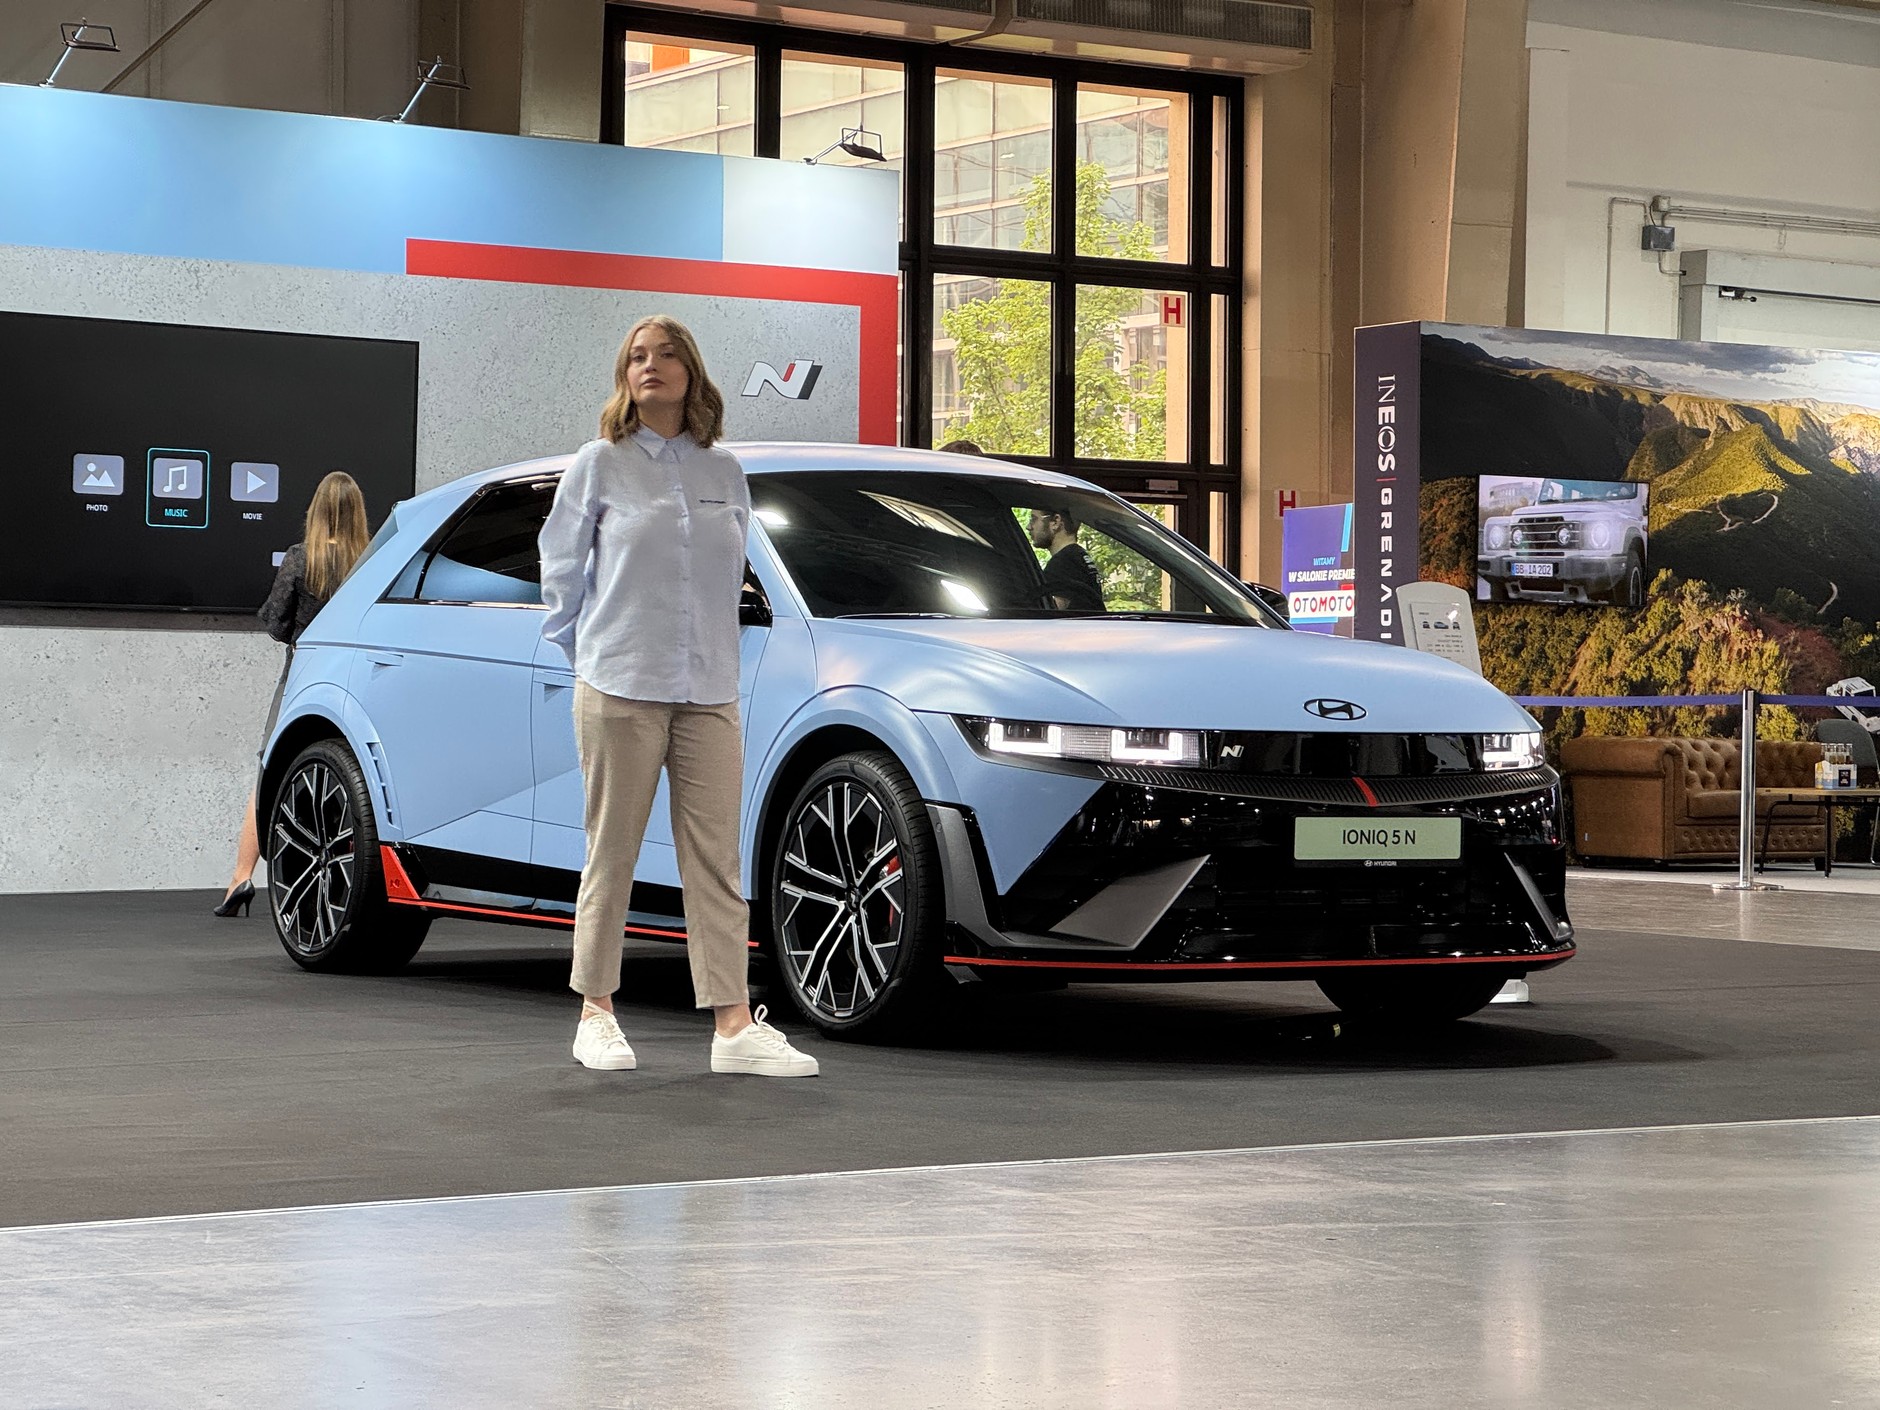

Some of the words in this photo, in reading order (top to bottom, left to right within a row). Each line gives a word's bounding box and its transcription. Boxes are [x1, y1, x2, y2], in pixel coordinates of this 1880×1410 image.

[1163, 296, 1181, 324] H
[1378, 374, 1396, 472] INEOS
[86, 504, 108, 512] PHOTO
[1279, 490, 1296, 517] H
[164, 508, 189, 518] MUSIC
[242, 513, 263, 521] MOVIE
[1313, 557, 1336, 566] WITAMY
[1380, 487, 1393, 639] GRENADI
[1288, 571, 1298, 583] W
[1297, 570, 1328, 583] SALONIE
[1293, 595, 1354, 612] OTOMOTO
[1342, 829, 1389, 847] IONIQ
[1392, 829, 1400, 845] 5
[1404, 829, 1416, 845] N
